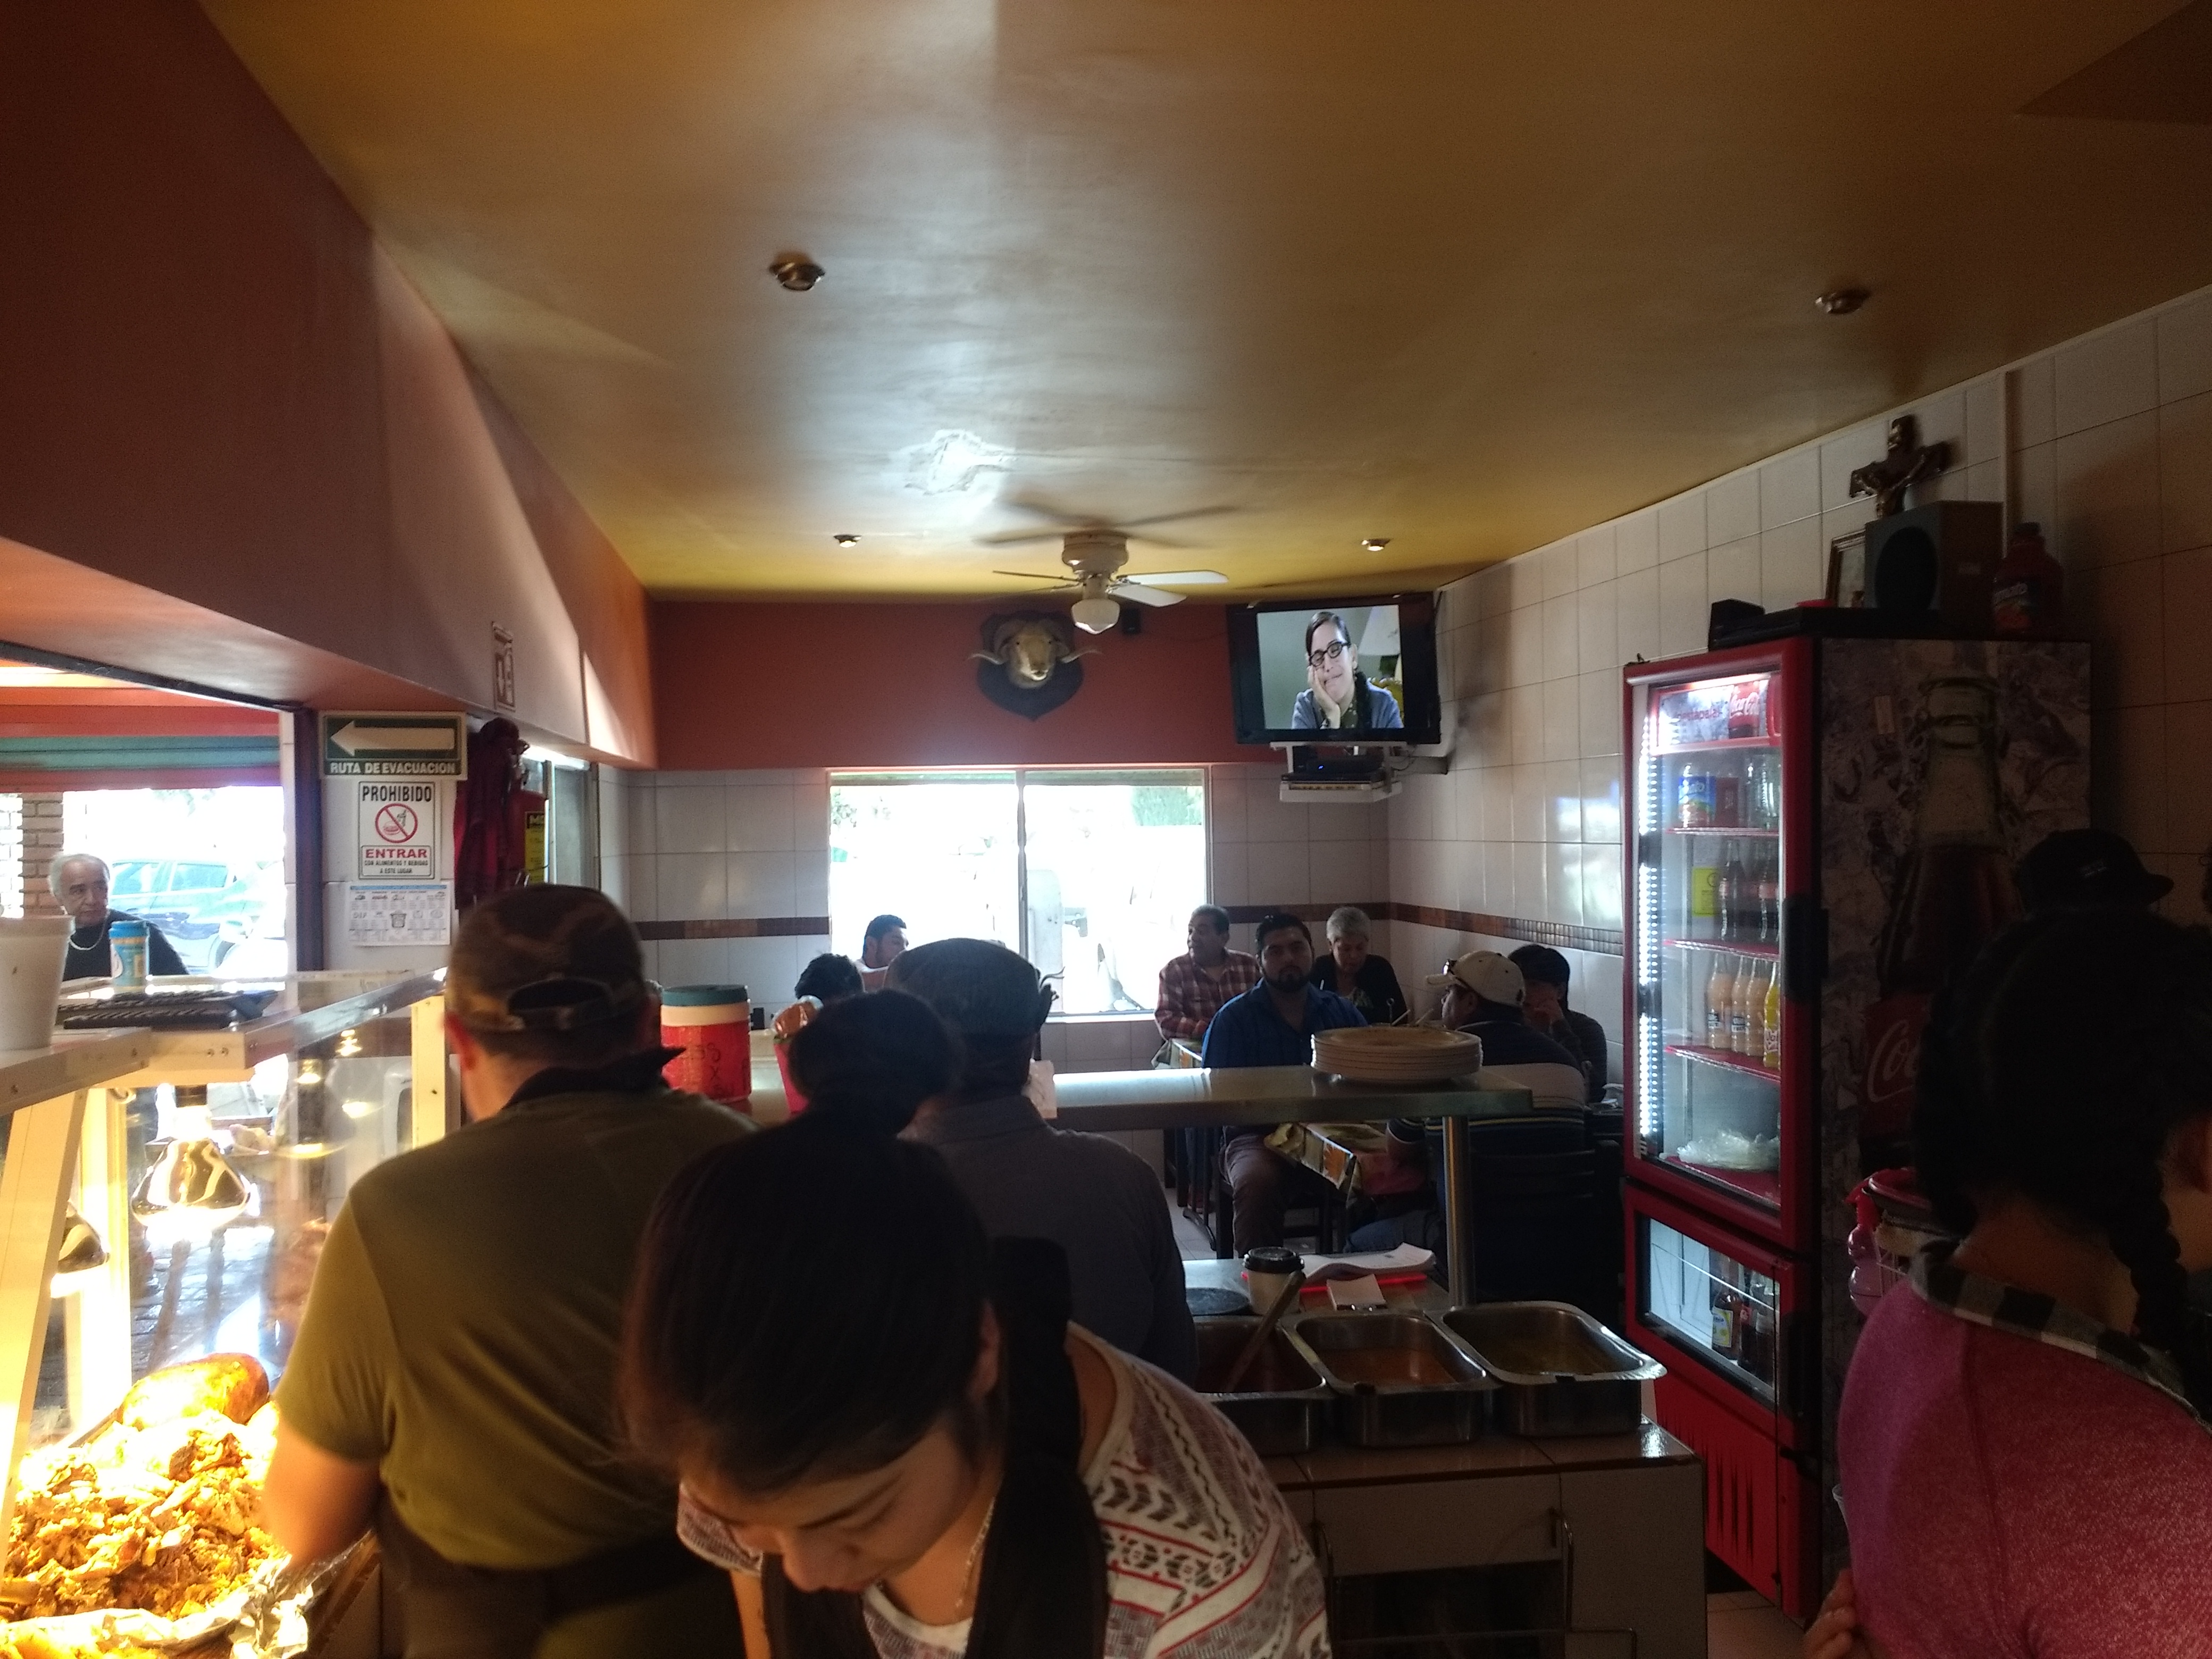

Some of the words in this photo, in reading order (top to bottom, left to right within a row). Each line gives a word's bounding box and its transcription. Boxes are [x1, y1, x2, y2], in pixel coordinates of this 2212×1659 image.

[330, 762, 361, 774] RUTA
[365, 762, 380, 774] DE
[382, 762, 456, 774] EVACUACION
[362, 785, 432, 802] PROHIBIDO
[365, 849, 427, 858] ENTRAR
